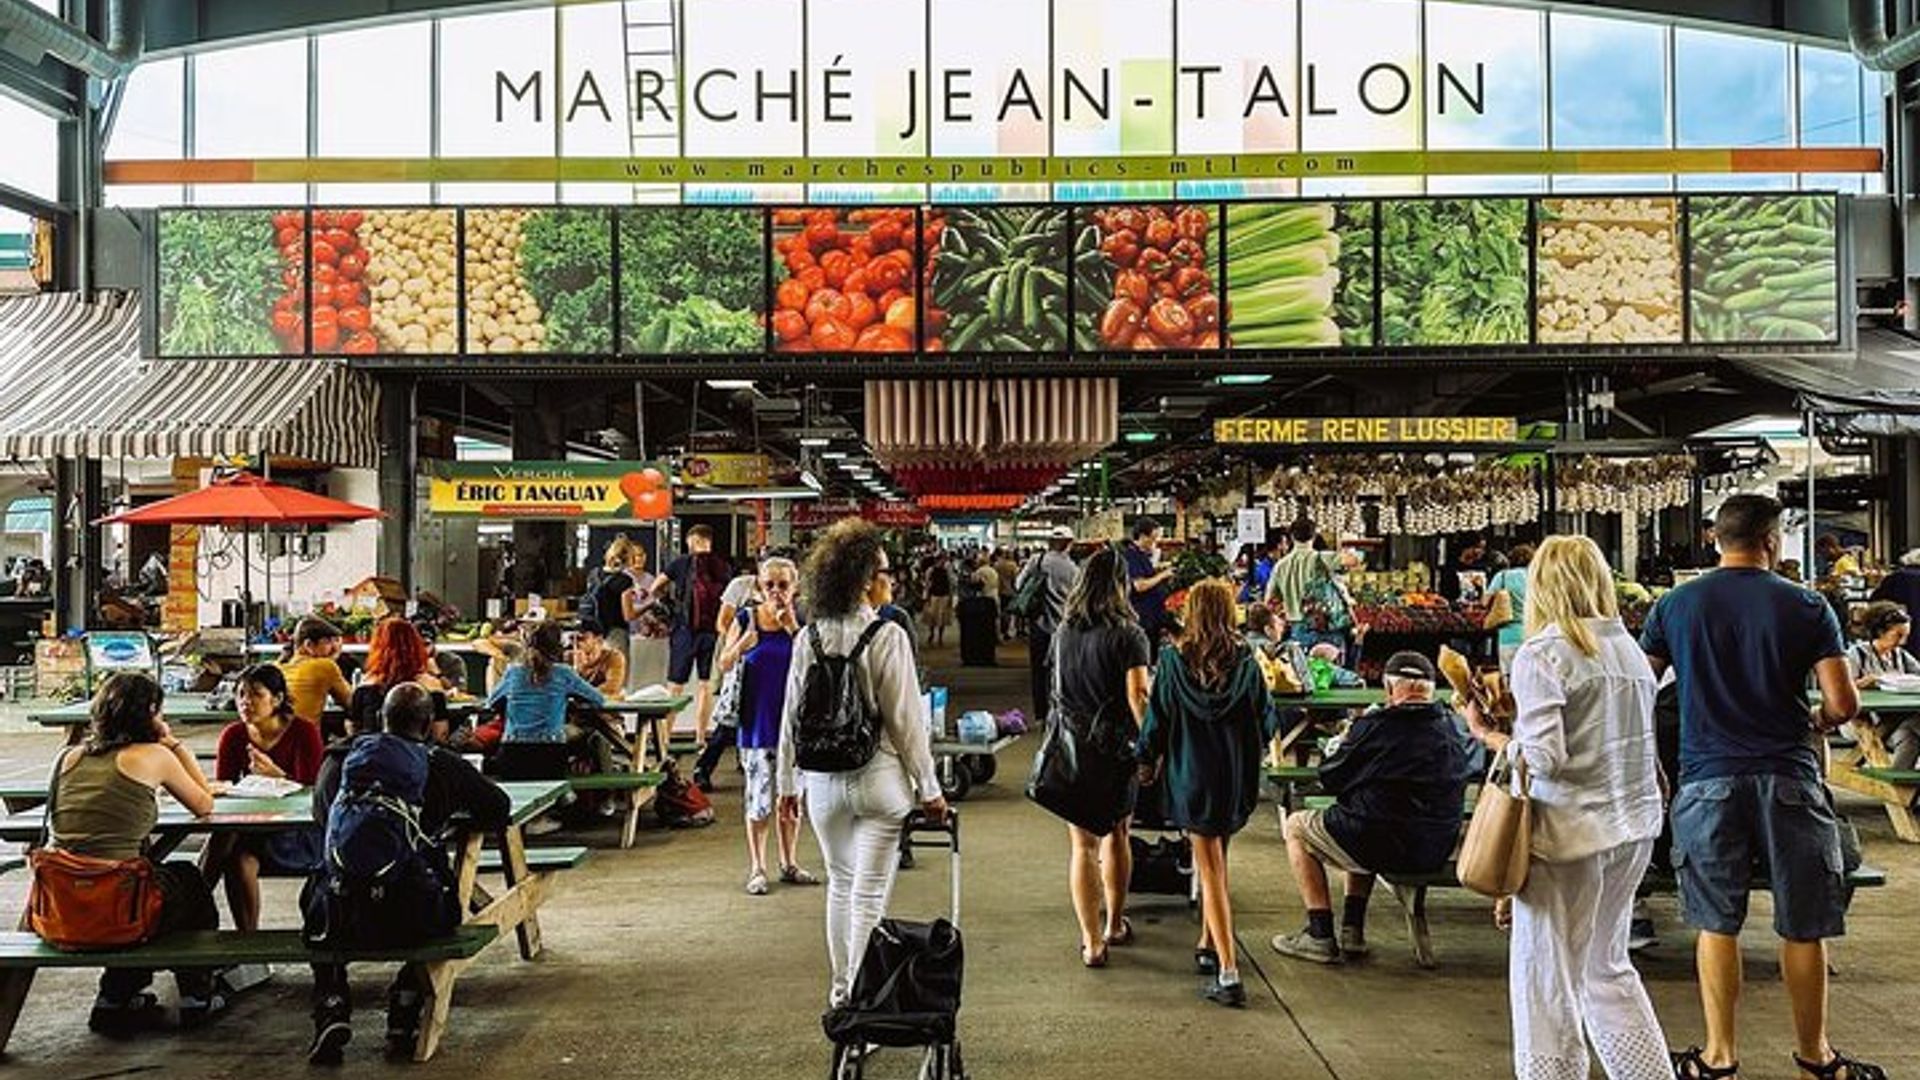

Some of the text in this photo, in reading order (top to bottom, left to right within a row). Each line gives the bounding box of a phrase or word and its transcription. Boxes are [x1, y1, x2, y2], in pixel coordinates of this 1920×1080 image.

[495, 55, 1485, 138] MARCHÉ JEAN-TALON
[625, 155, 1356, 180] www.marchespublics-mtl.com
[1220, 417, 1508, 443] FERME RENE LUSSIER
[493, 465, 575, 479] VERGER
[457, 481, 609, 501] ÉRIC TANGUAY
